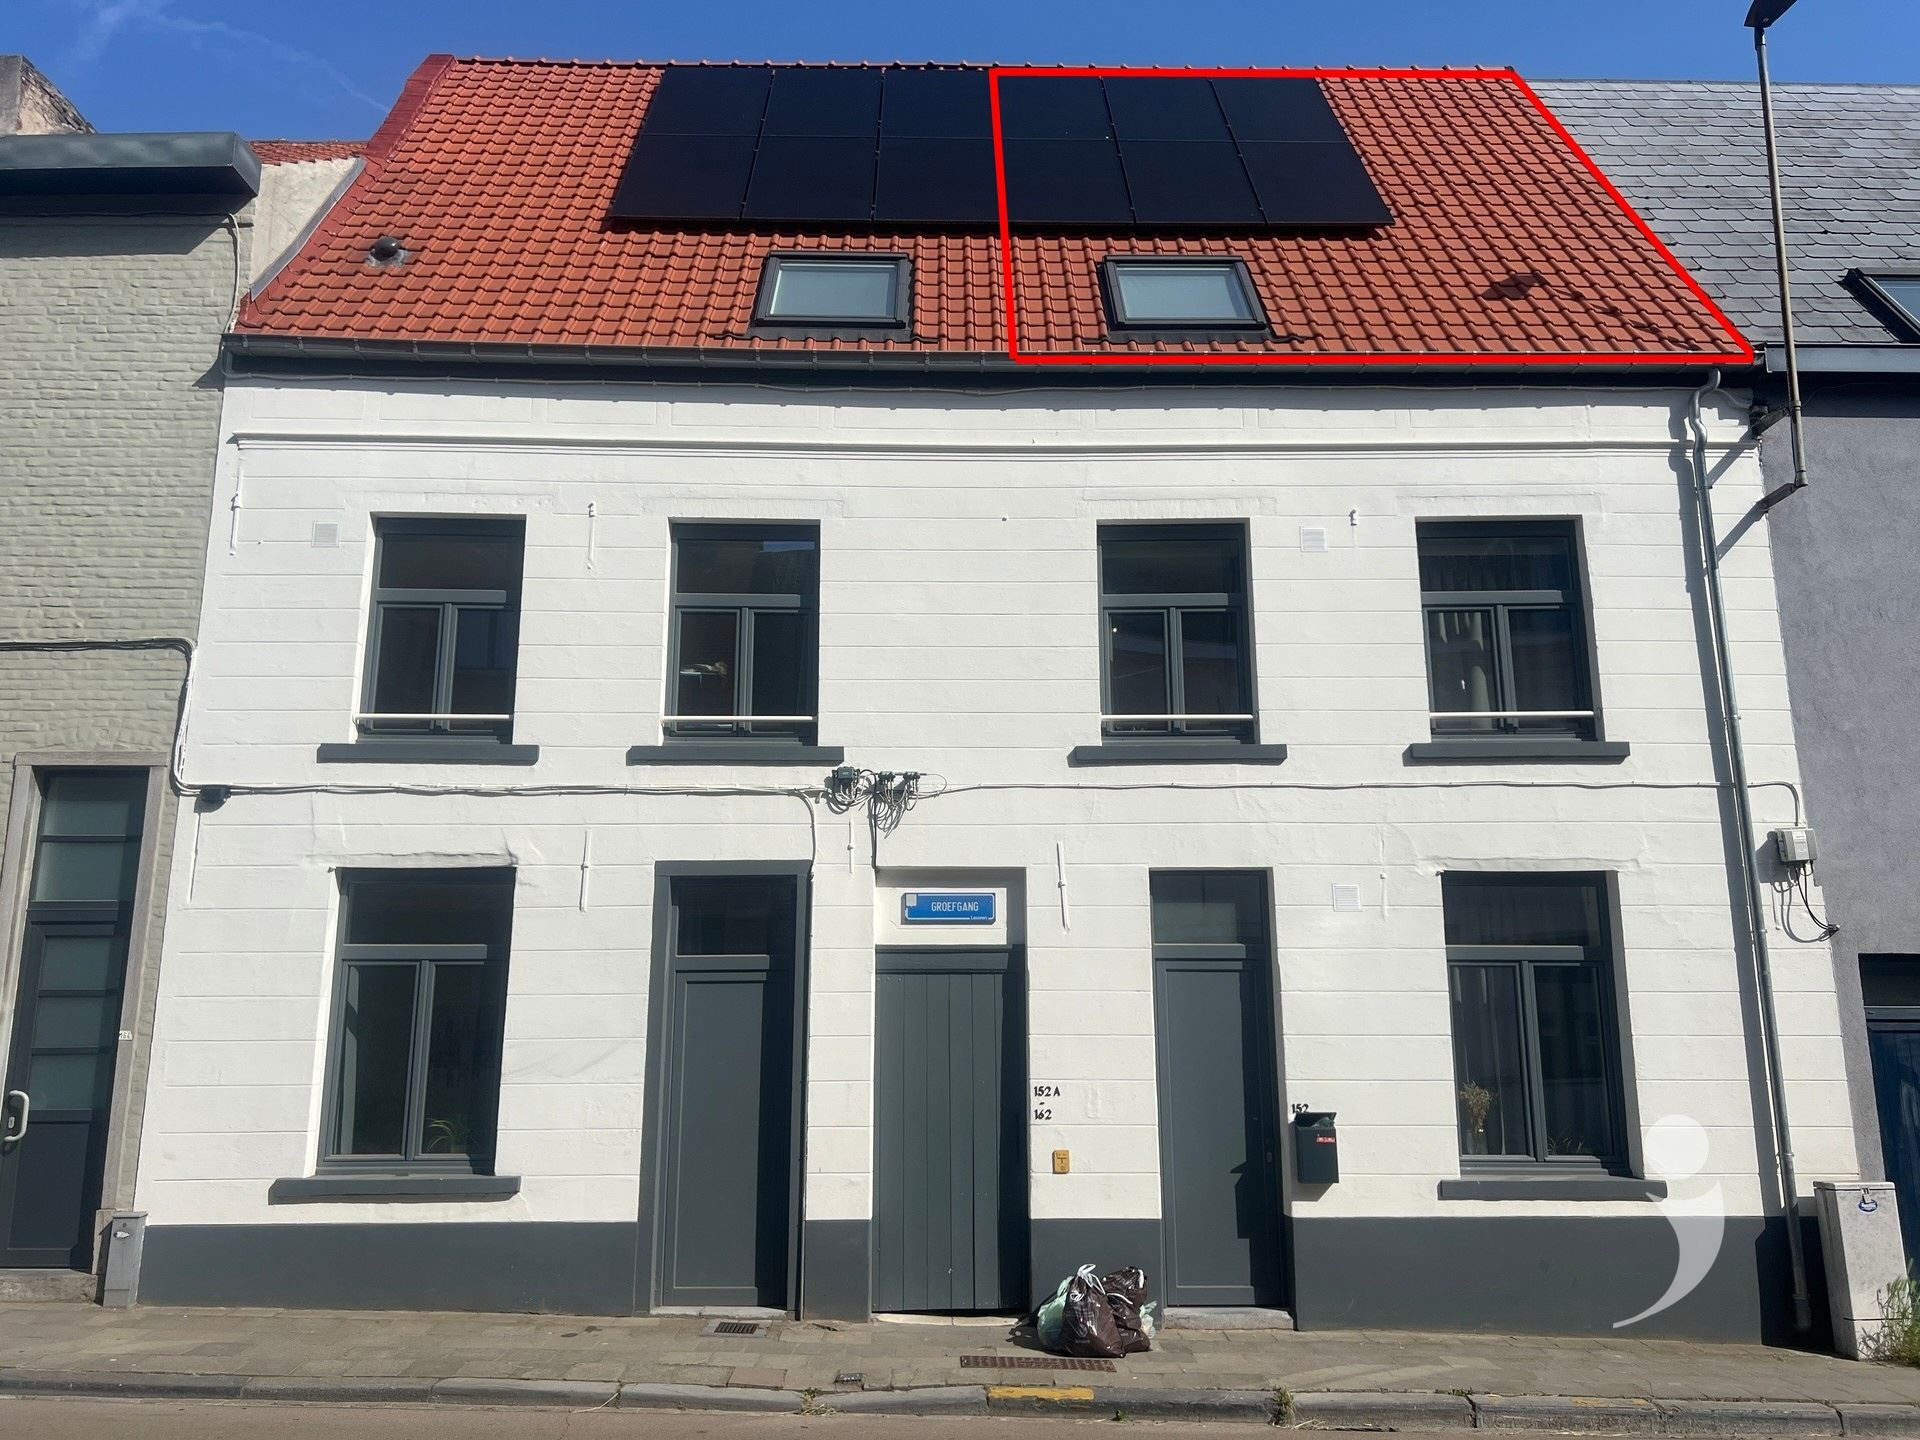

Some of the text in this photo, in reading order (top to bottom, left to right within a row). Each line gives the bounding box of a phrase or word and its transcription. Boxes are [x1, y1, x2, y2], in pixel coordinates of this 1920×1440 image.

[931, 901, 979, 912] GROEFGANG
[1291, 1103, 1309, 1113] 152
[1034, 1109, 1052, 1120] 162
